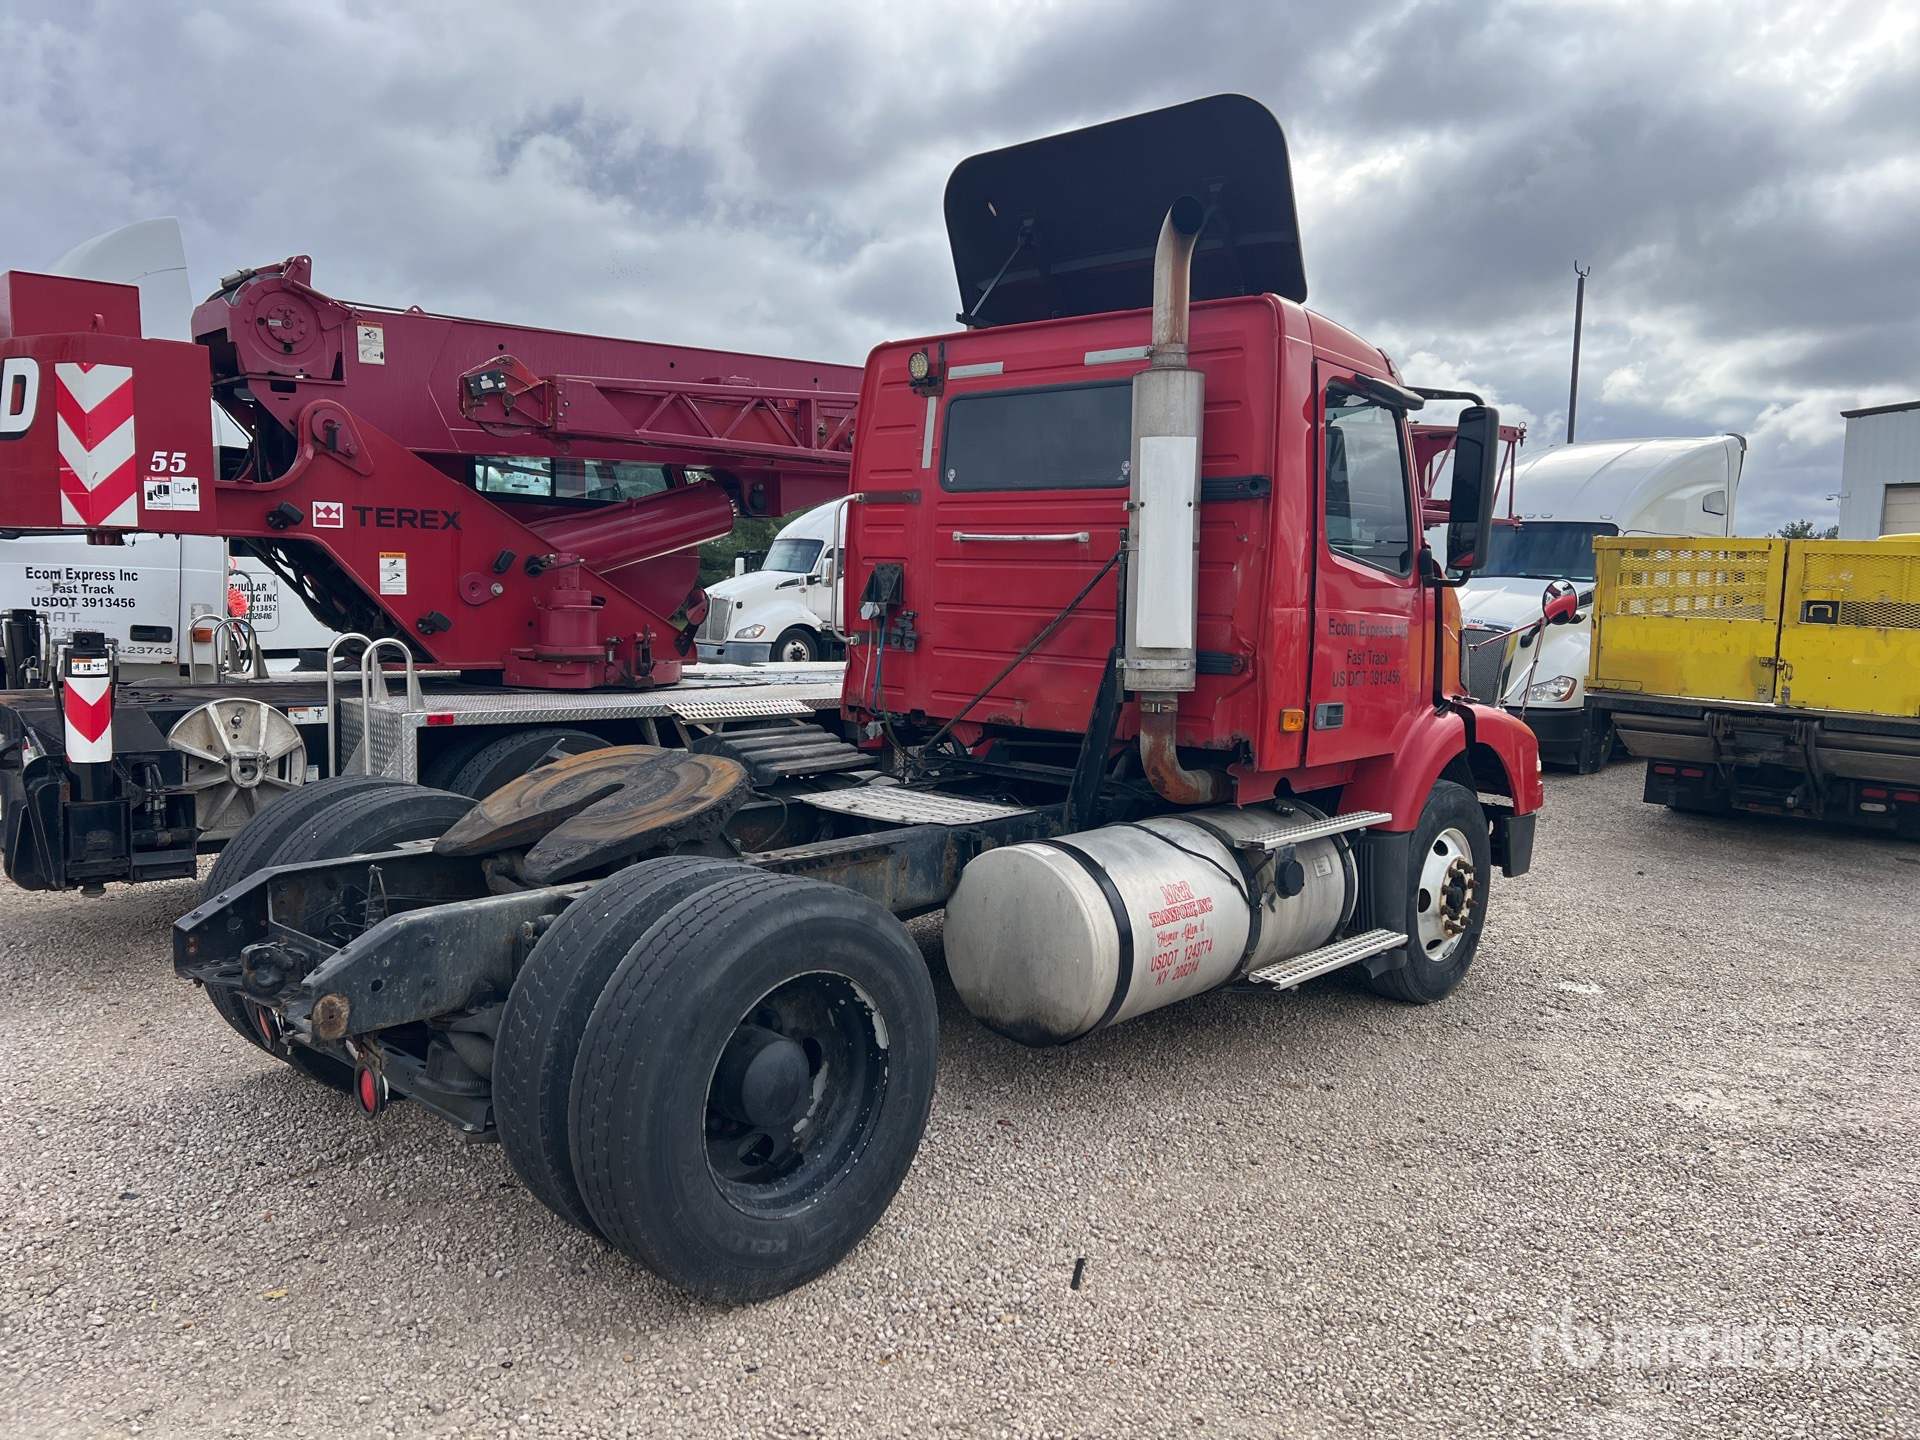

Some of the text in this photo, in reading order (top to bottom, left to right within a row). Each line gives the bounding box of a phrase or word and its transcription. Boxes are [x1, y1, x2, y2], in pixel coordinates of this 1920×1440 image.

[150, 451, 187, 473] 55
[352, 505, 462, 531] TEREX
[25, 566, 138, 582] Ecom Express Inc
[52, 583, 115, 594] Fast Track
[31, 597, 136, 608] USDOT 3913456
[264, 594, 277, 602] INC
[1328, 618, 1356, 636] Ecom
[1359, 620, 1394, 640] Express
[1346, 649, 1389, 666] Fast Track
[1332, 670, 1401, 688] US DOT 3913456
[1160, 880, 1195, 906] M&R
[1150, 938, 1213, 972] USDOT 1243774
[1155, 970, 1170, 986] KY
